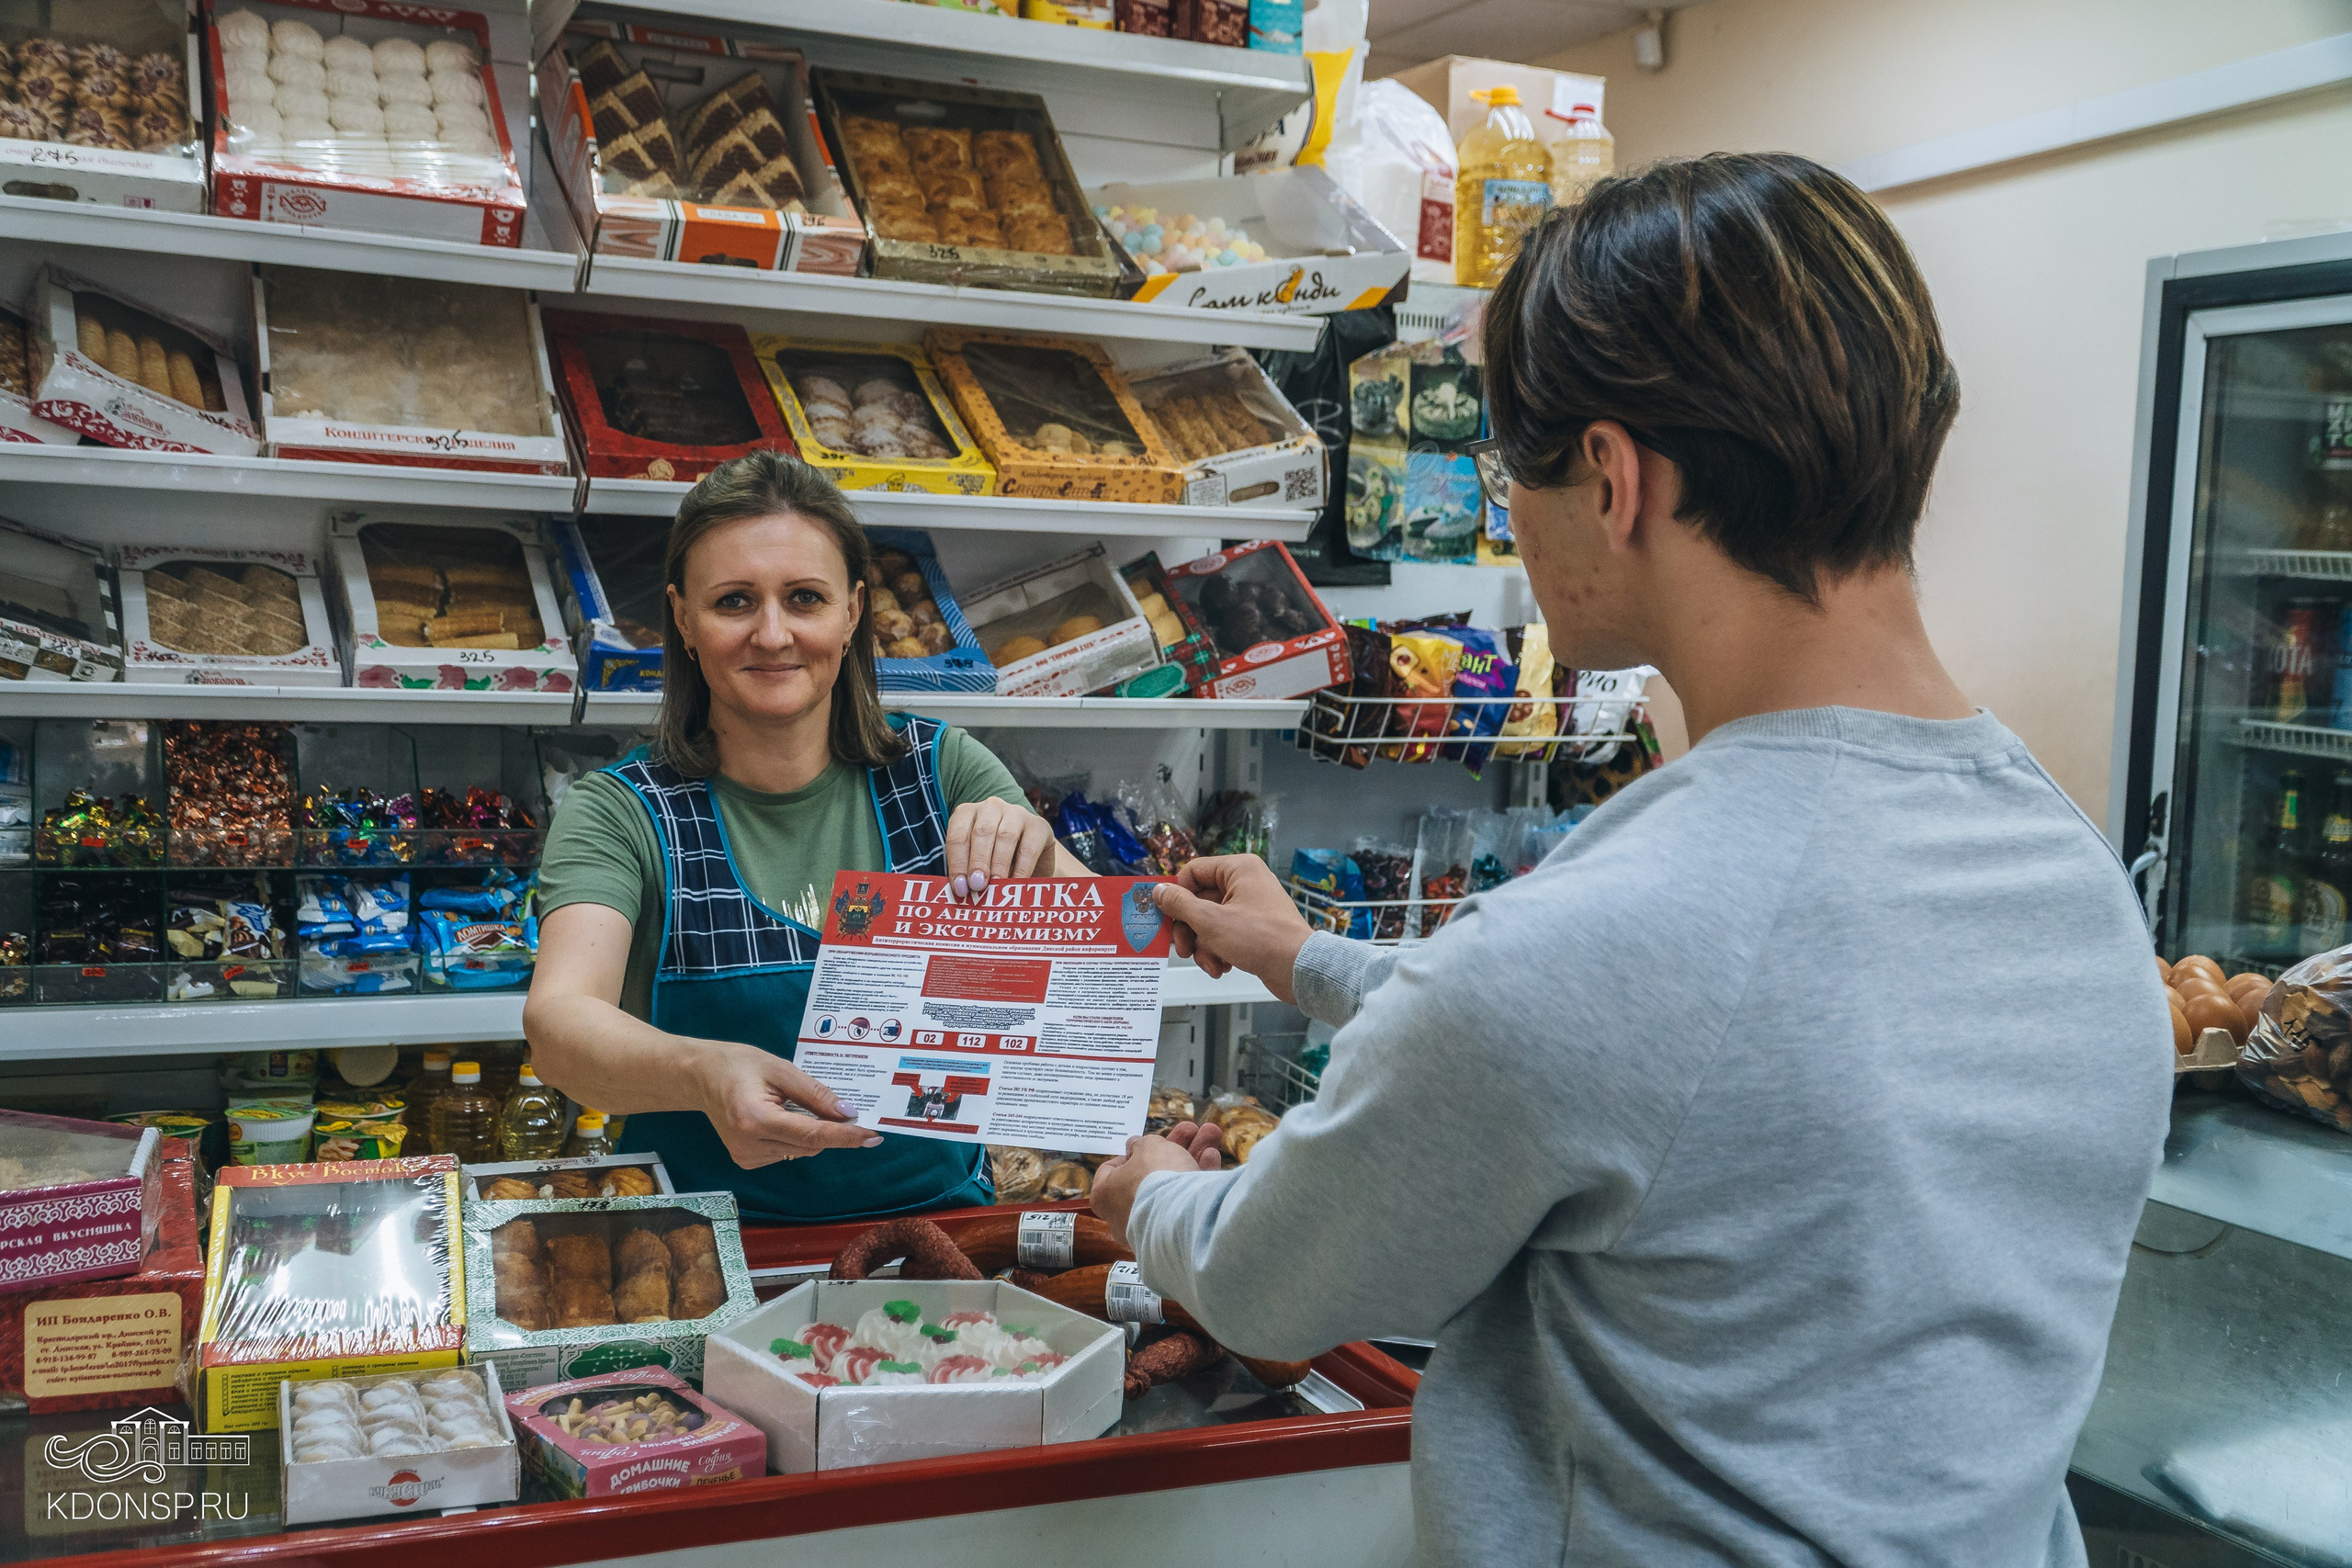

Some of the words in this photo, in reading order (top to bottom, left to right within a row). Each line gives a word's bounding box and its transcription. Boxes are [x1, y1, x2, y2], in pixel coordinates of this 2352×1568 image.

[459, 649, 494, 662] 325
[899, 879, 1105, 908] ПАМЯТКА
[896, 905, 932, 918] ПО
[937, 908, 1104, 924] АНТИТЕРРОРУ
[456, 923, 506, 942] ЛОМТИШКА
[893, 921, 912, 934] И
[918, 921, 1102, 942] ЭКСТРЕМИЗМУ
[923, 1034, 936, 1043] 02
[962, 1036, 981, 1045] 112
[1004, 1039, 1023, 1048] 102
[252, 1168, 311, 1185] Вкус
[53, 1223, 131, 1242] ВКУСНЯШКА
[37, 1315, 58, 1325] ИП
[62, 1311, 140, 1325] Бондаренко
[143, 1309, 171, 1319] О.В.
[698, 1449, 733, 1473] София
[610, 1460, 691, 1490] ДОМАШНИЕ
